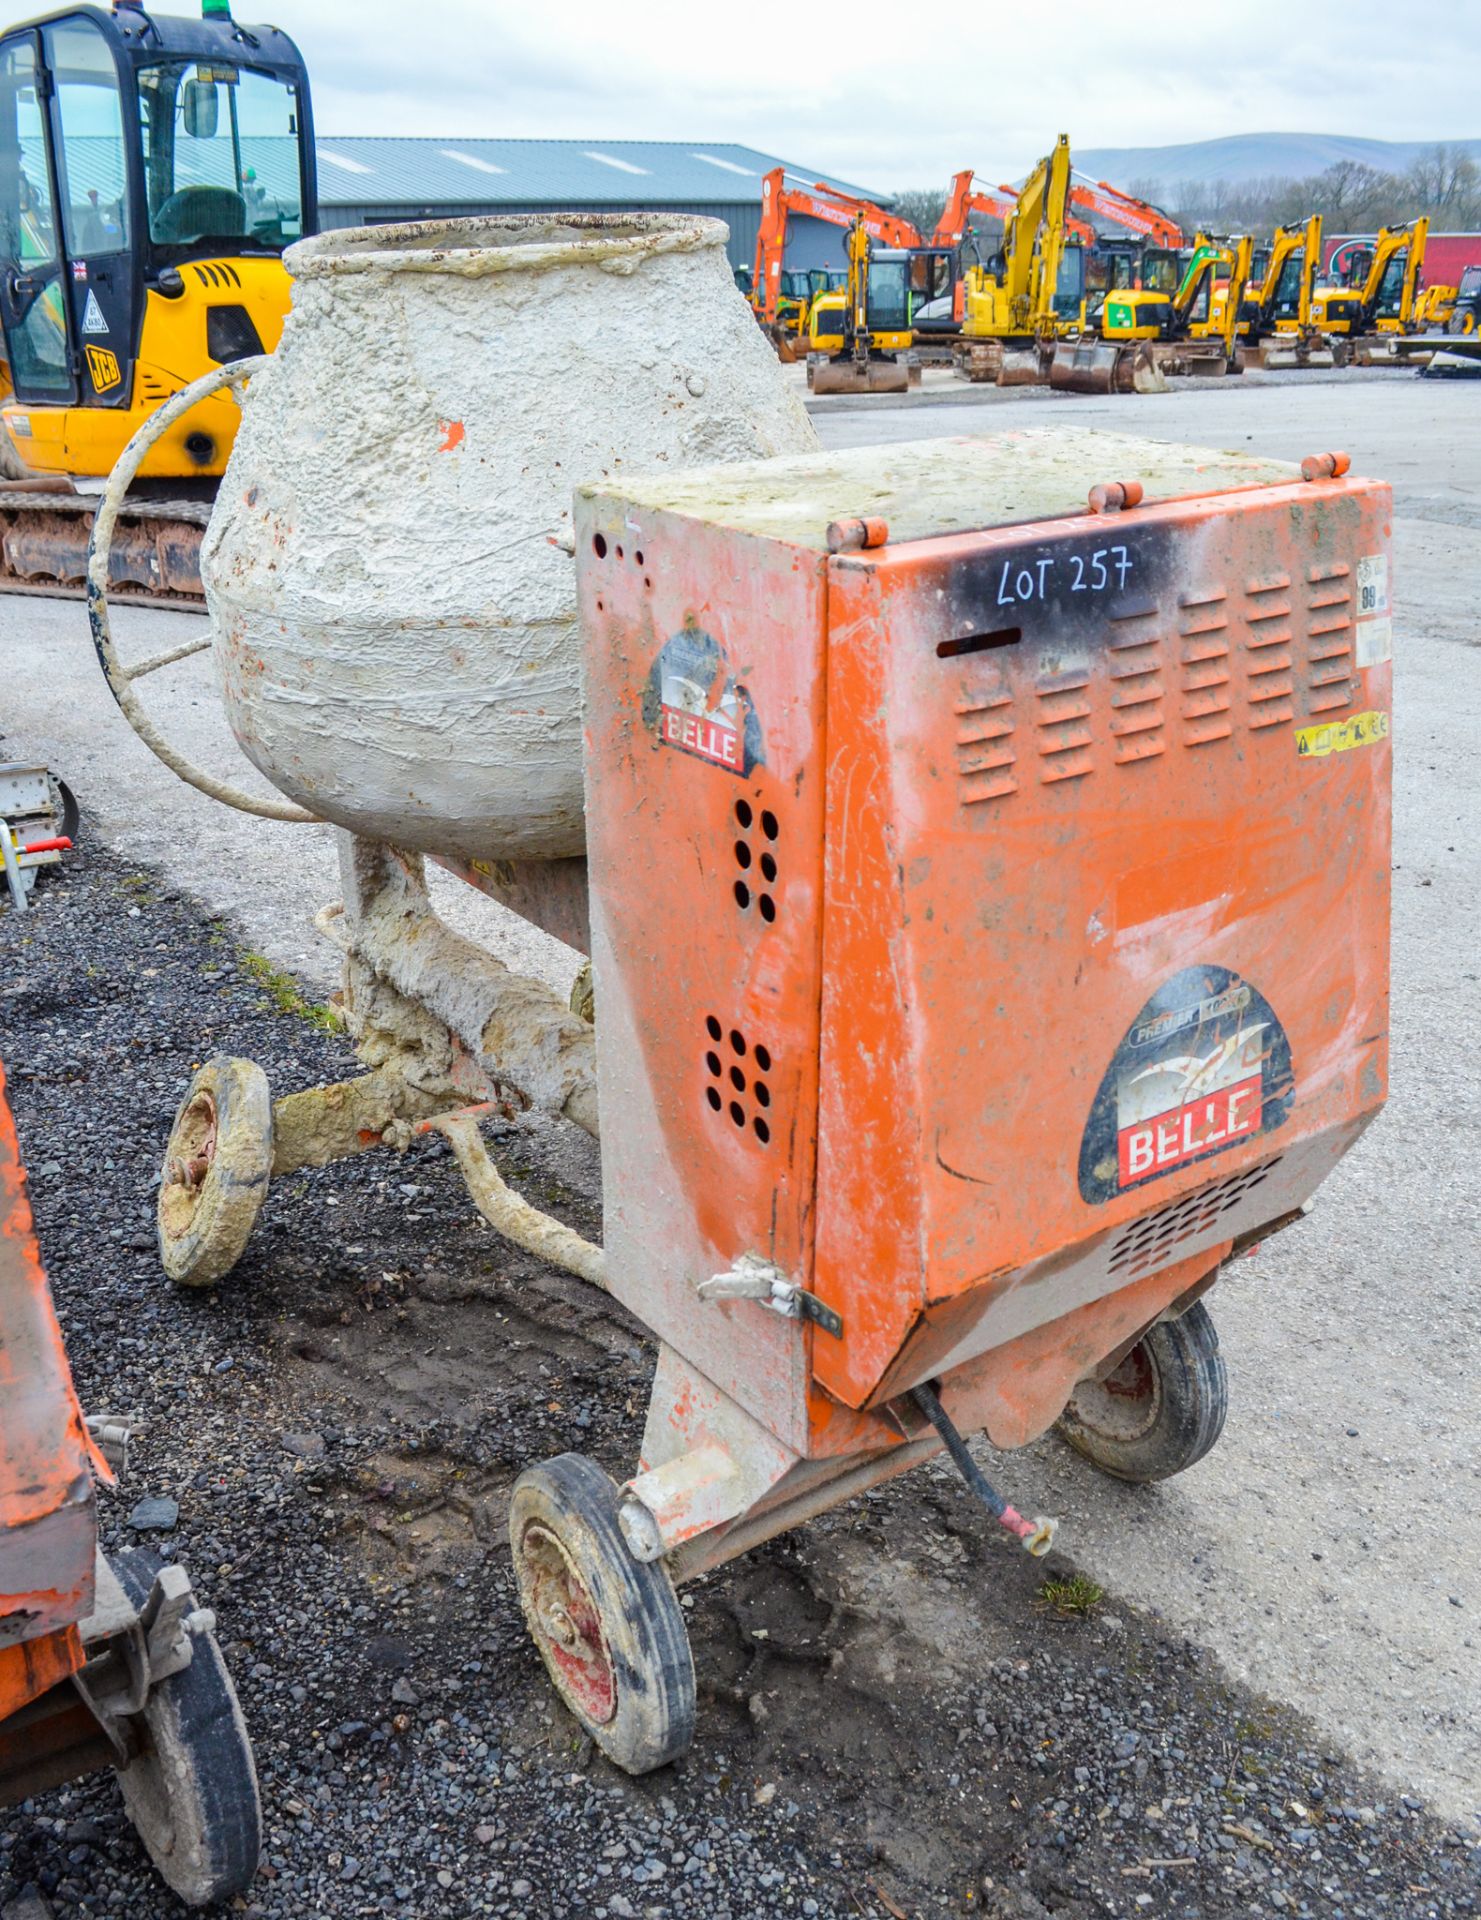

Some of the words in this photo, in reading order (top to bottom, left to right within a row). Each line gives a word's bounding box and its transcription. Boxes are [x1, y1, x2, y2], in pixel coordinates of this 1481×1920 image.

[91, 350, 118, 388] JCB
[997, 559, 1055, 605] LOT
[1069, 545, 1133, 592] 257
[667, 711, 737, 765] BELLE
[1128, 1088, 1250, 1176] BELLE
